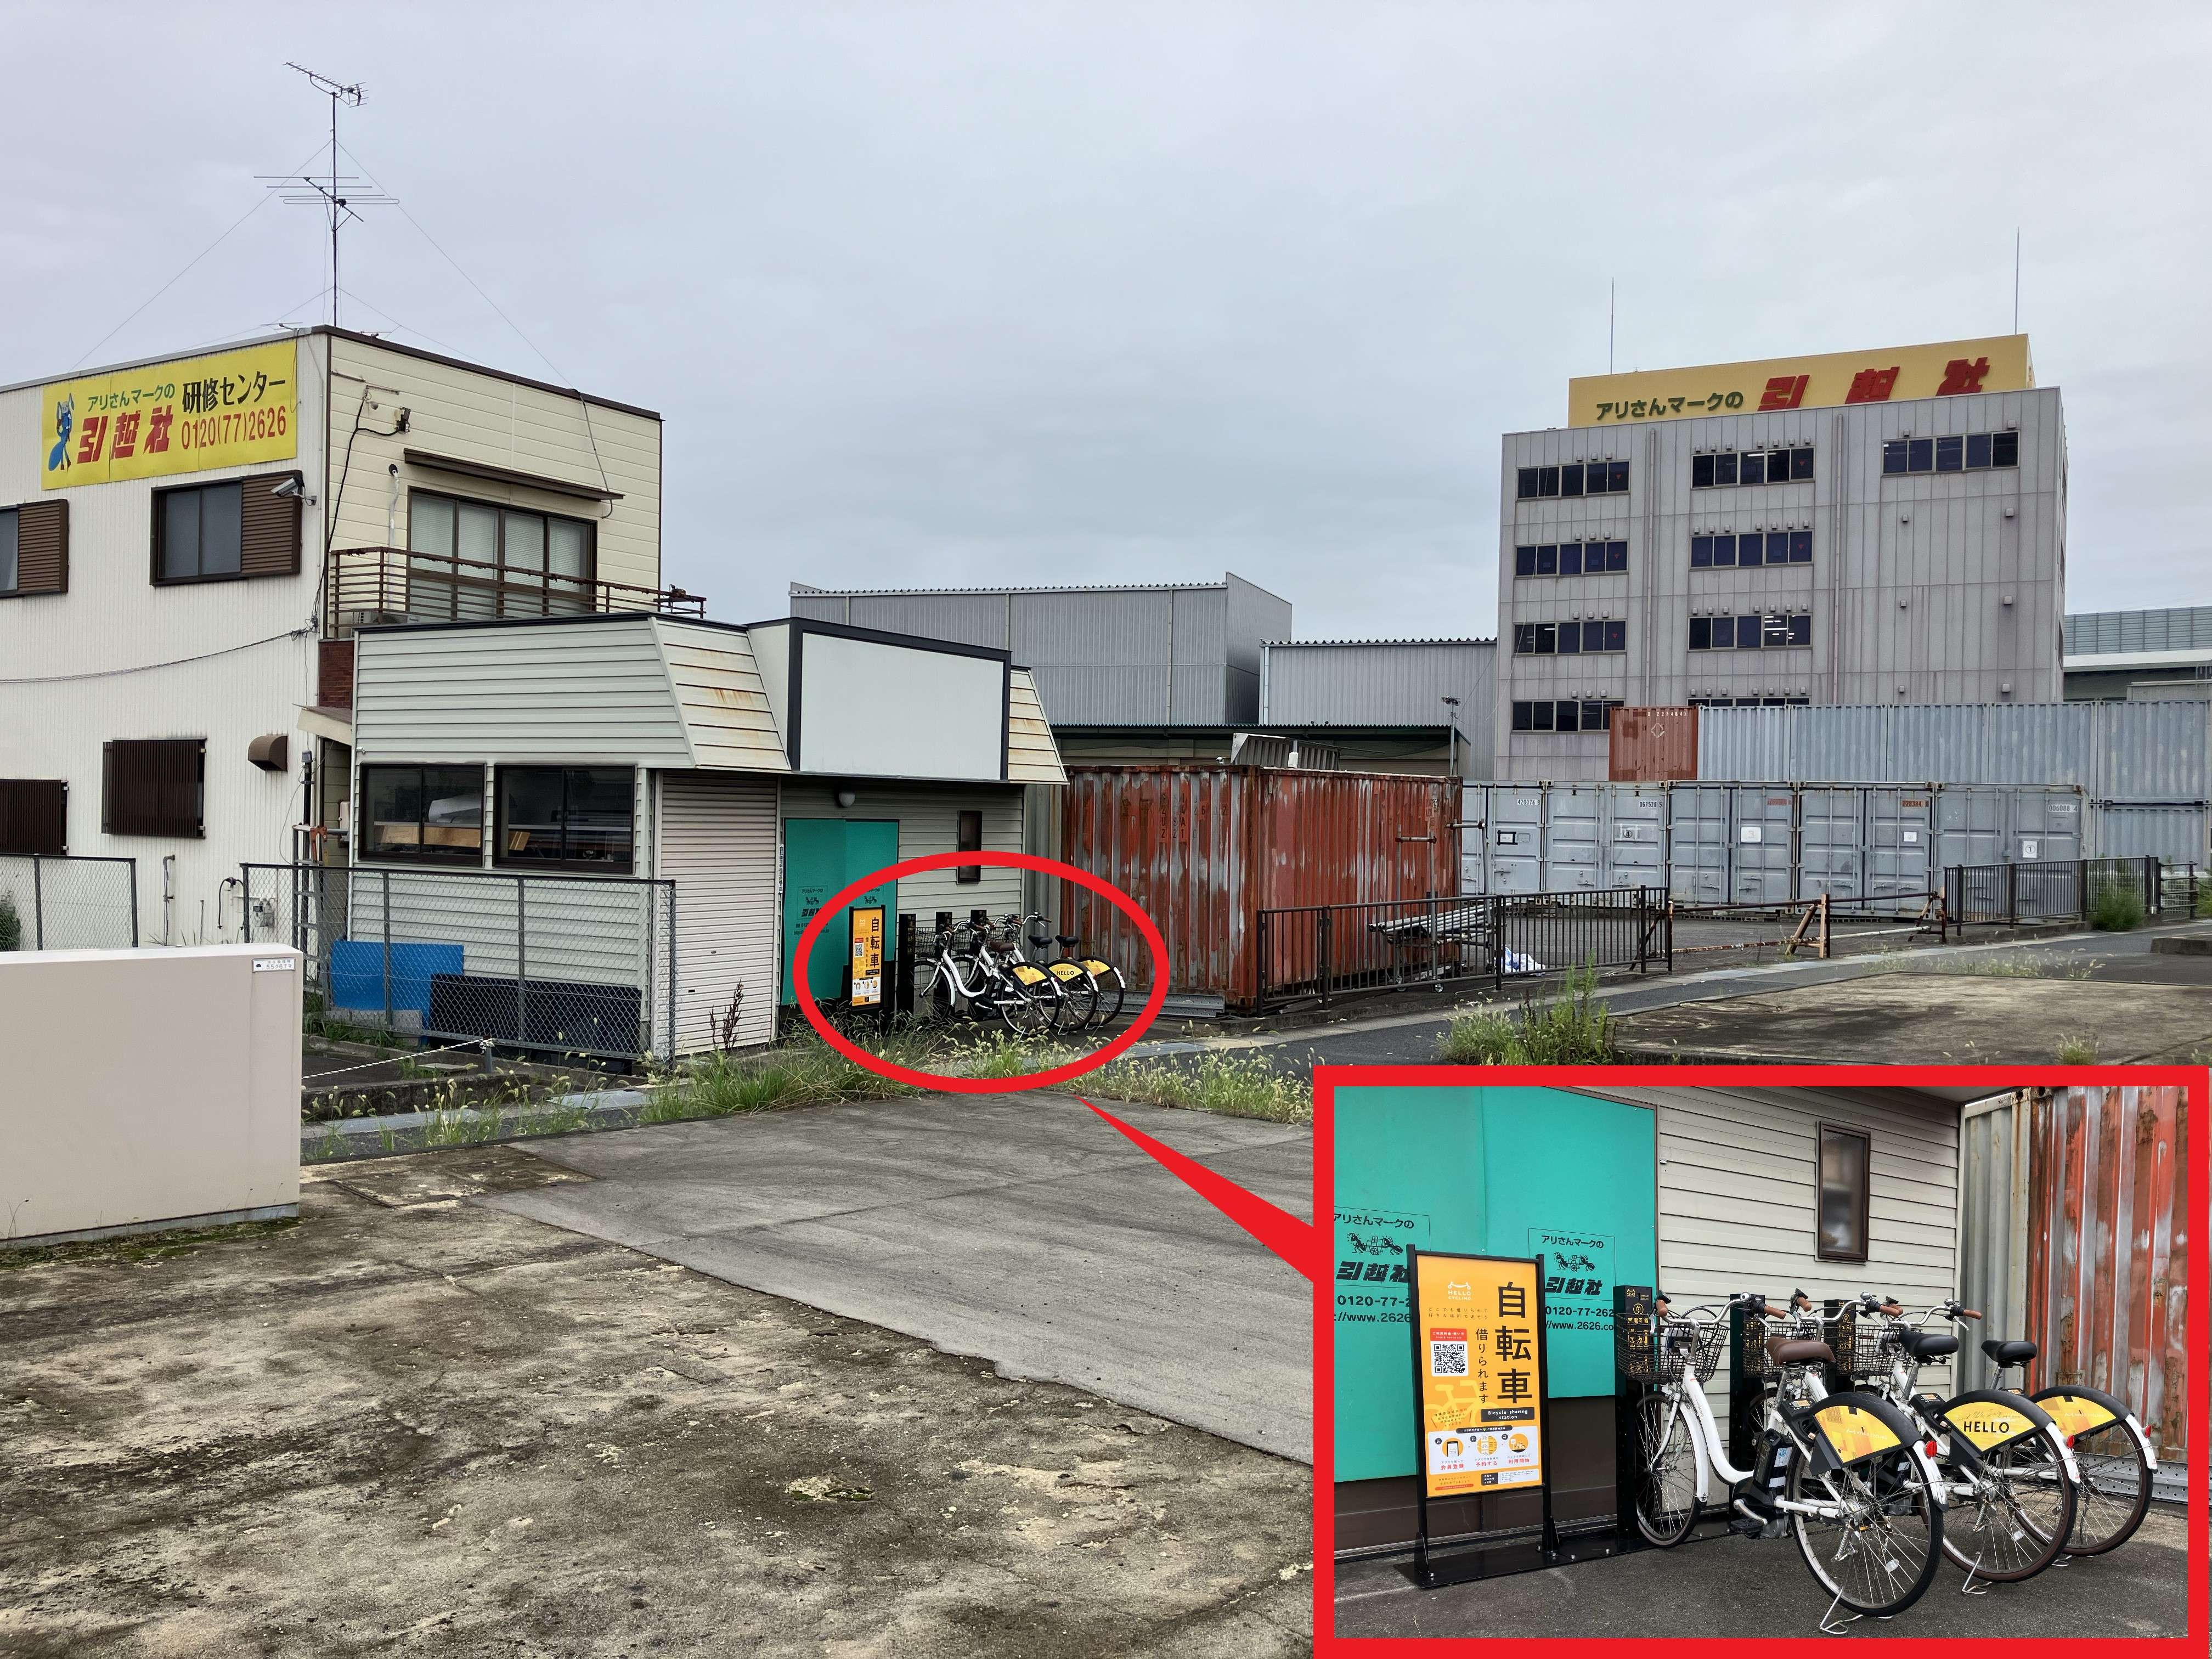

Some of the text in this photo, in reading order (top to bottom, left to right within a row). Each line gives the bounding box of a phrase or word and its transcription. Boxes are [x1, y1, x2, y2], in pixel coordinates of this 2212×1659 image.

[88, 383, 176, 412] アリさんマークの
[182, 371, 286, 414] 研修センター
[1596, 357, 1990, 420] アリさんマークの 引越社
[77, 404, 173, 464] 引越社
[181, 405, 286, 450] 0120(77)2626
[870, 917, 880, 968] 自転車
[1542, 1235, 1604, 1249] アリさんマークの
[1545, 1276, 1602, 1296] 引越社
[1494, 1281, 1532, 1404] 自転車
[1475, 1328, 1489, 1403] 借りられます
[1963, 1421, 2010, 1434] HELLO
